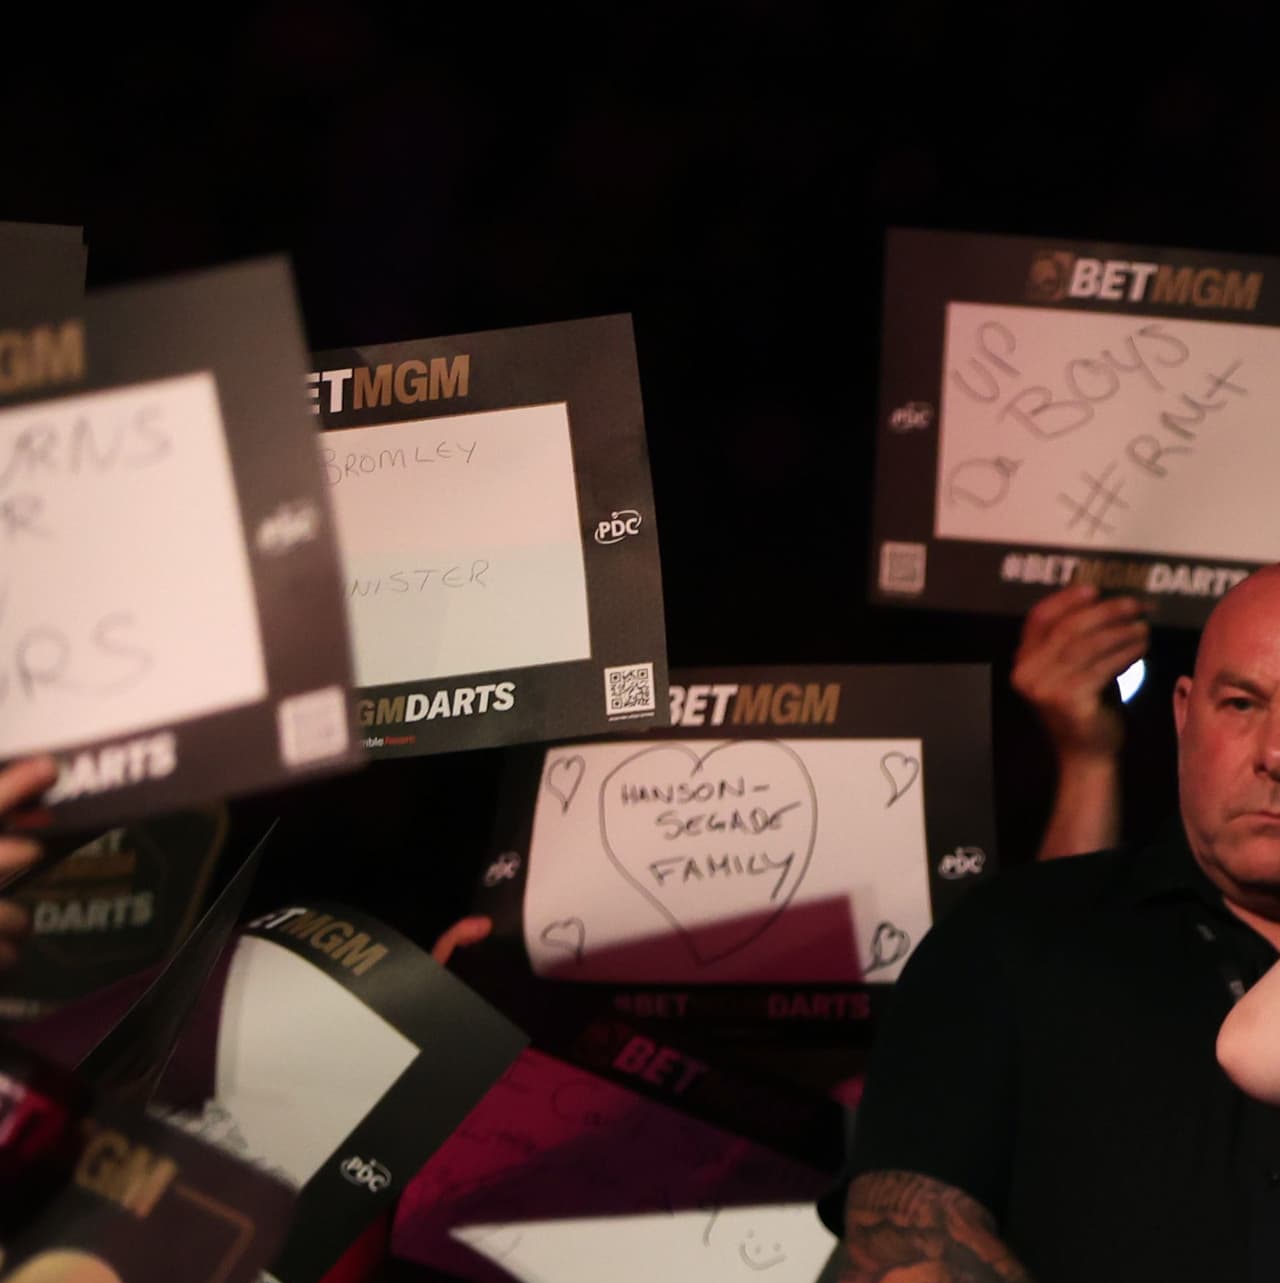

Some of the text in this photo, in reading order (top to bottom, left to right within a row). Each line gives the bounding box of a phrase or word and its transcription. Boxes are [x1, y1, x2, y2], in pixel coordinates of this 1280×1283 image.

[1067, 256, 1265, 312] BETMGM
[322, 440, 477, 487] BROMLEY
[594, 510, 643, 545] PDC
[669, 682, 842, 727] BETMGM
[649, 851, 795, 902] FAMILY
